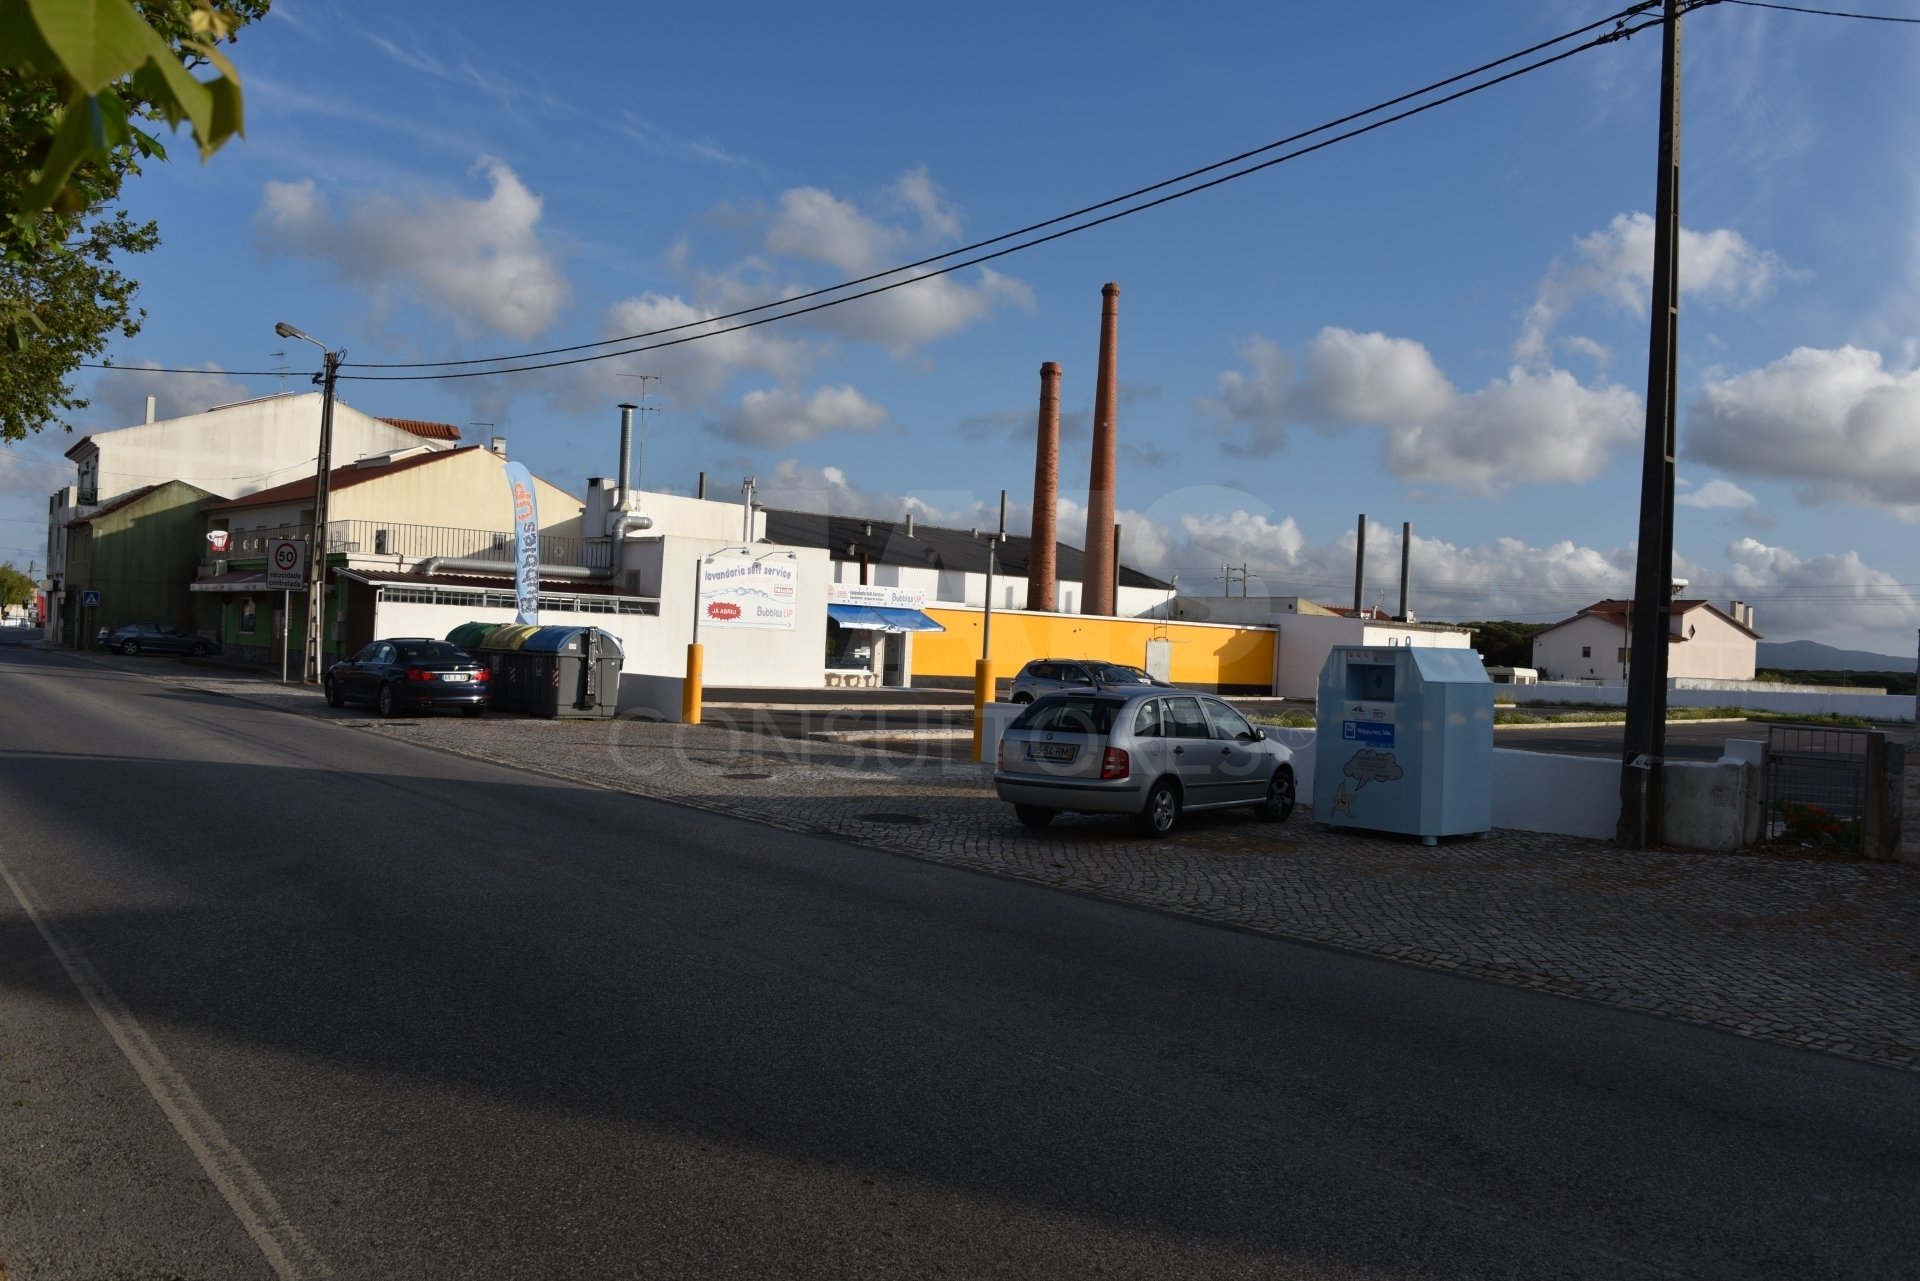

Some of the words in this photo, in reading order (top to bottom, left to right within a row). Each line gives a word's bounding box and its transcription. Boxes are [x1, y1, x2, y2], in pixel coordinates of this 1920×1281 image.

[279, 551, 294, 562] 50
[704, 565, 745, 581] lavandaria
[763, 567, 792, 579] service
[269, 580, 301, 588] controlada
[719, 608, 737, 616] ABRIU
[756, 606, 783, 618] Bubbles
[783, 609, 794, 617] UP
